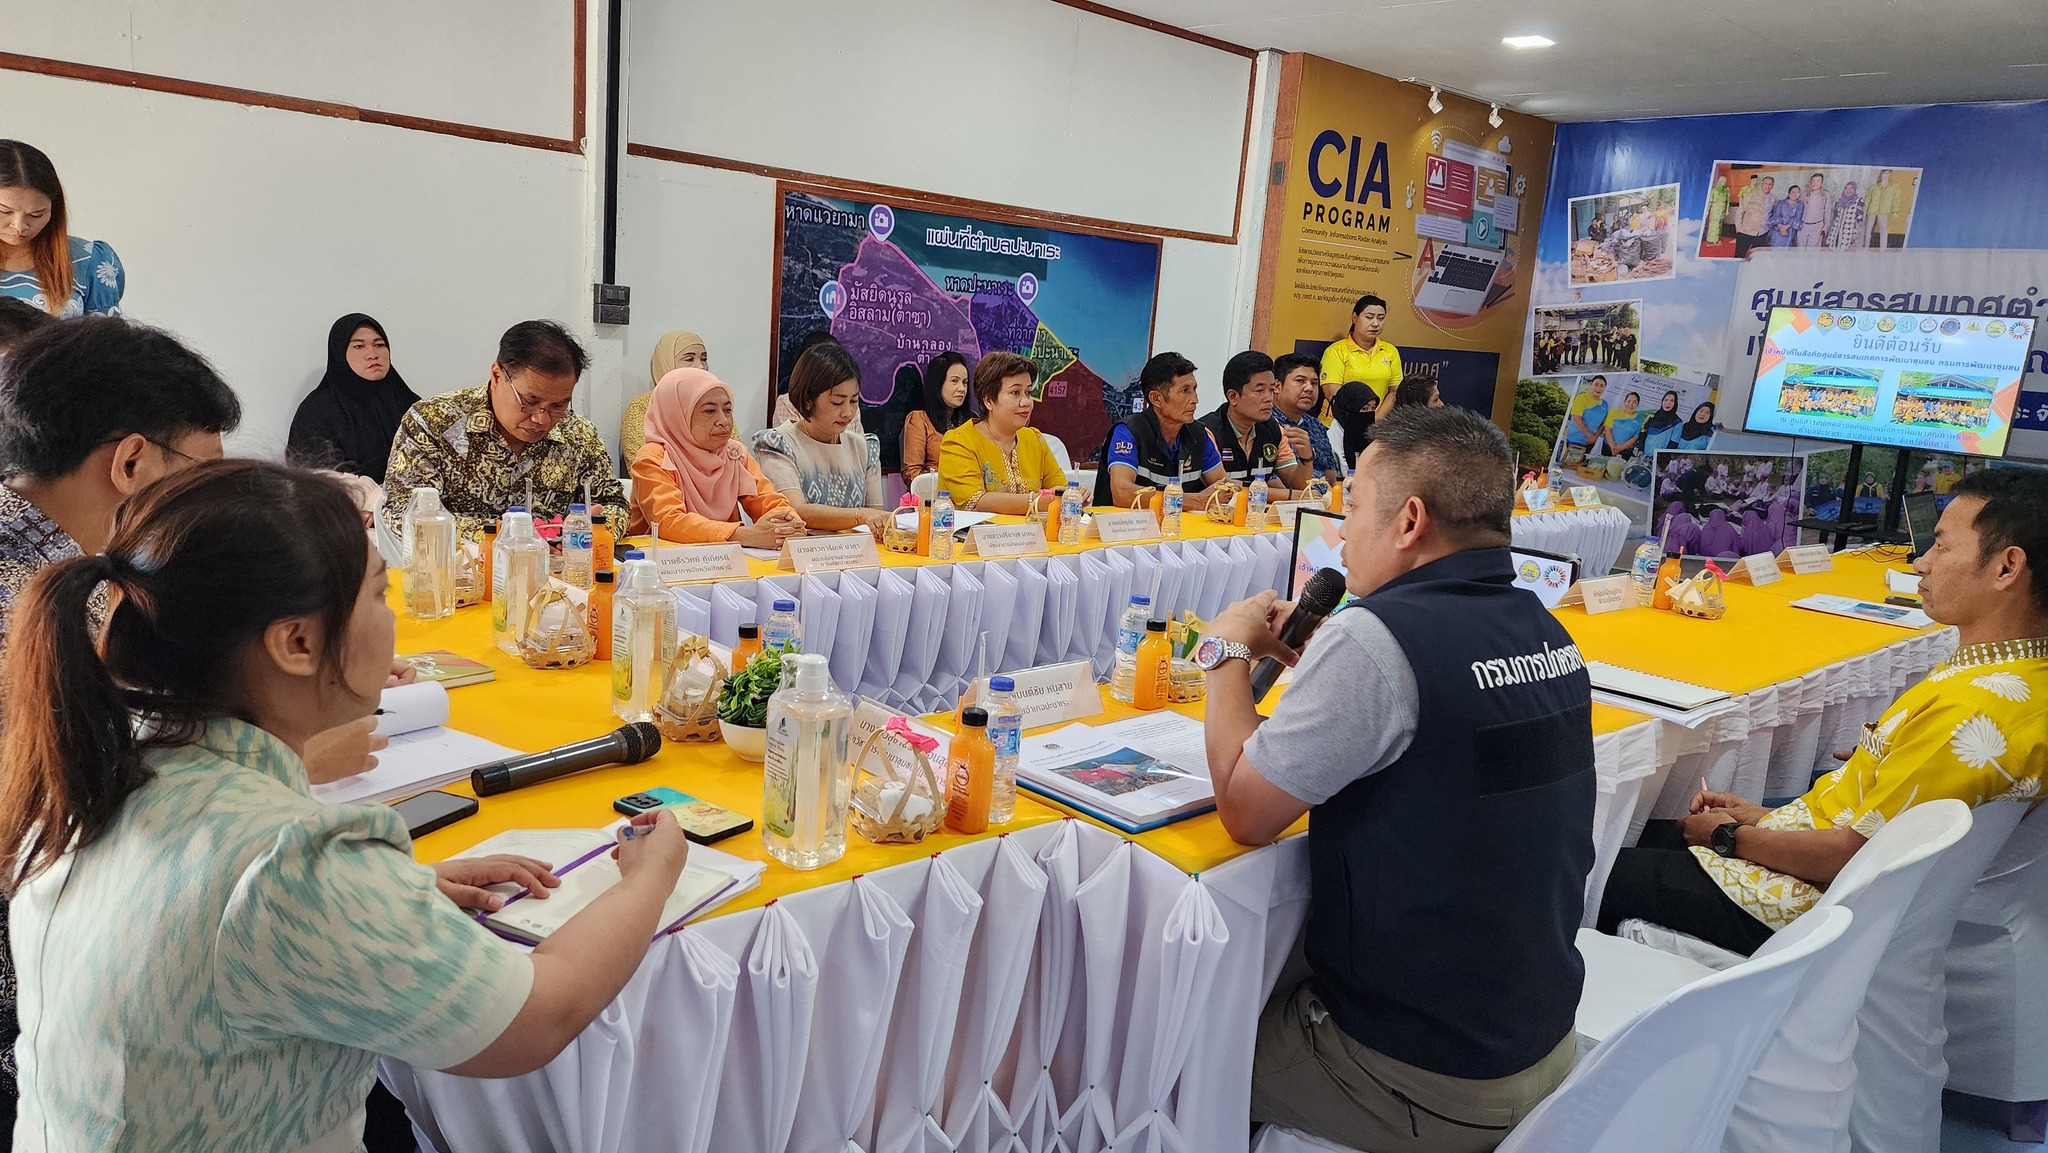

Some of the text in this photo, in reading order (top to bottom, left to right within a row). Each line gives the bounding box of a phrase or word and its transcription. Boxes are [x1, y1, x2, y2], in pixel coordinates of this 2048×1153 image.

[1308, 129, 1391, 210] CIA
[784, 204, 866, 231] หาดแวยามา
[1303, 201, 1391, 233] PROGRAM
[1301, 227, 1389, 246] Community Informations Radar Analysis
[850, 281, 913, 309] มัสยิดนูรูล
[944, 273, 1016, 297] หาดปะนาเระ
[848, 301, 932, 328] อิสลาม(ตาซา)
[1007, 319, 1047, 341] ที่ว่าการ
[1852, 332, 1943, 355] ยินดีต้อนรับ
[1050, 384, 1067, 395] 4157
[1046, 681, 1073, 695] หนูสาย
